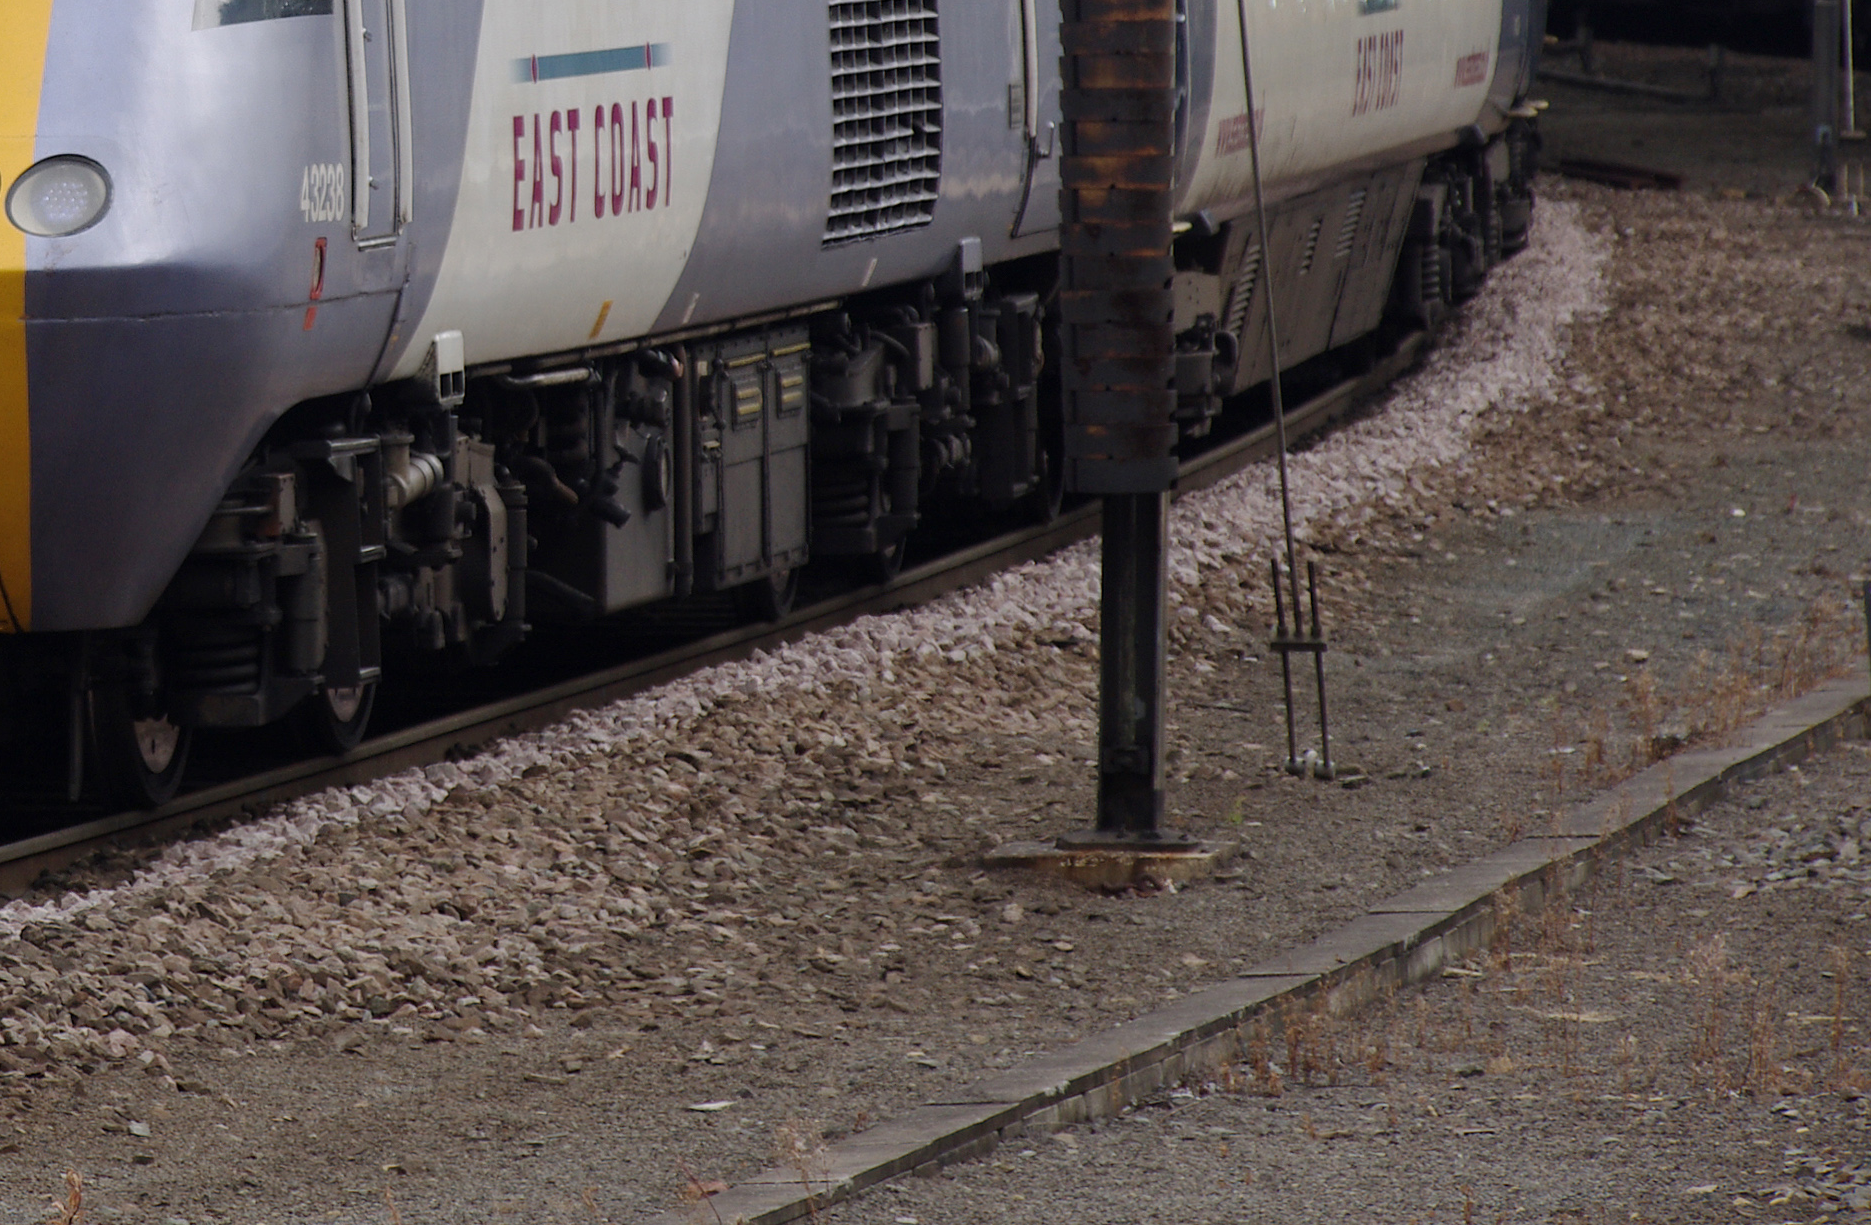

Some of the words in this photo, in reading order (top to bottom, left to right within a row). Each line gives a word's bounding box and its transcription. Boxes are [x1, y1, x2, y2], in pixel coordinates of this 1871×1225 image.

[300, 162, 345, 223] 43238
[512, 108, 581, 232] EAST
[594, 96, 674, 220] COAST
